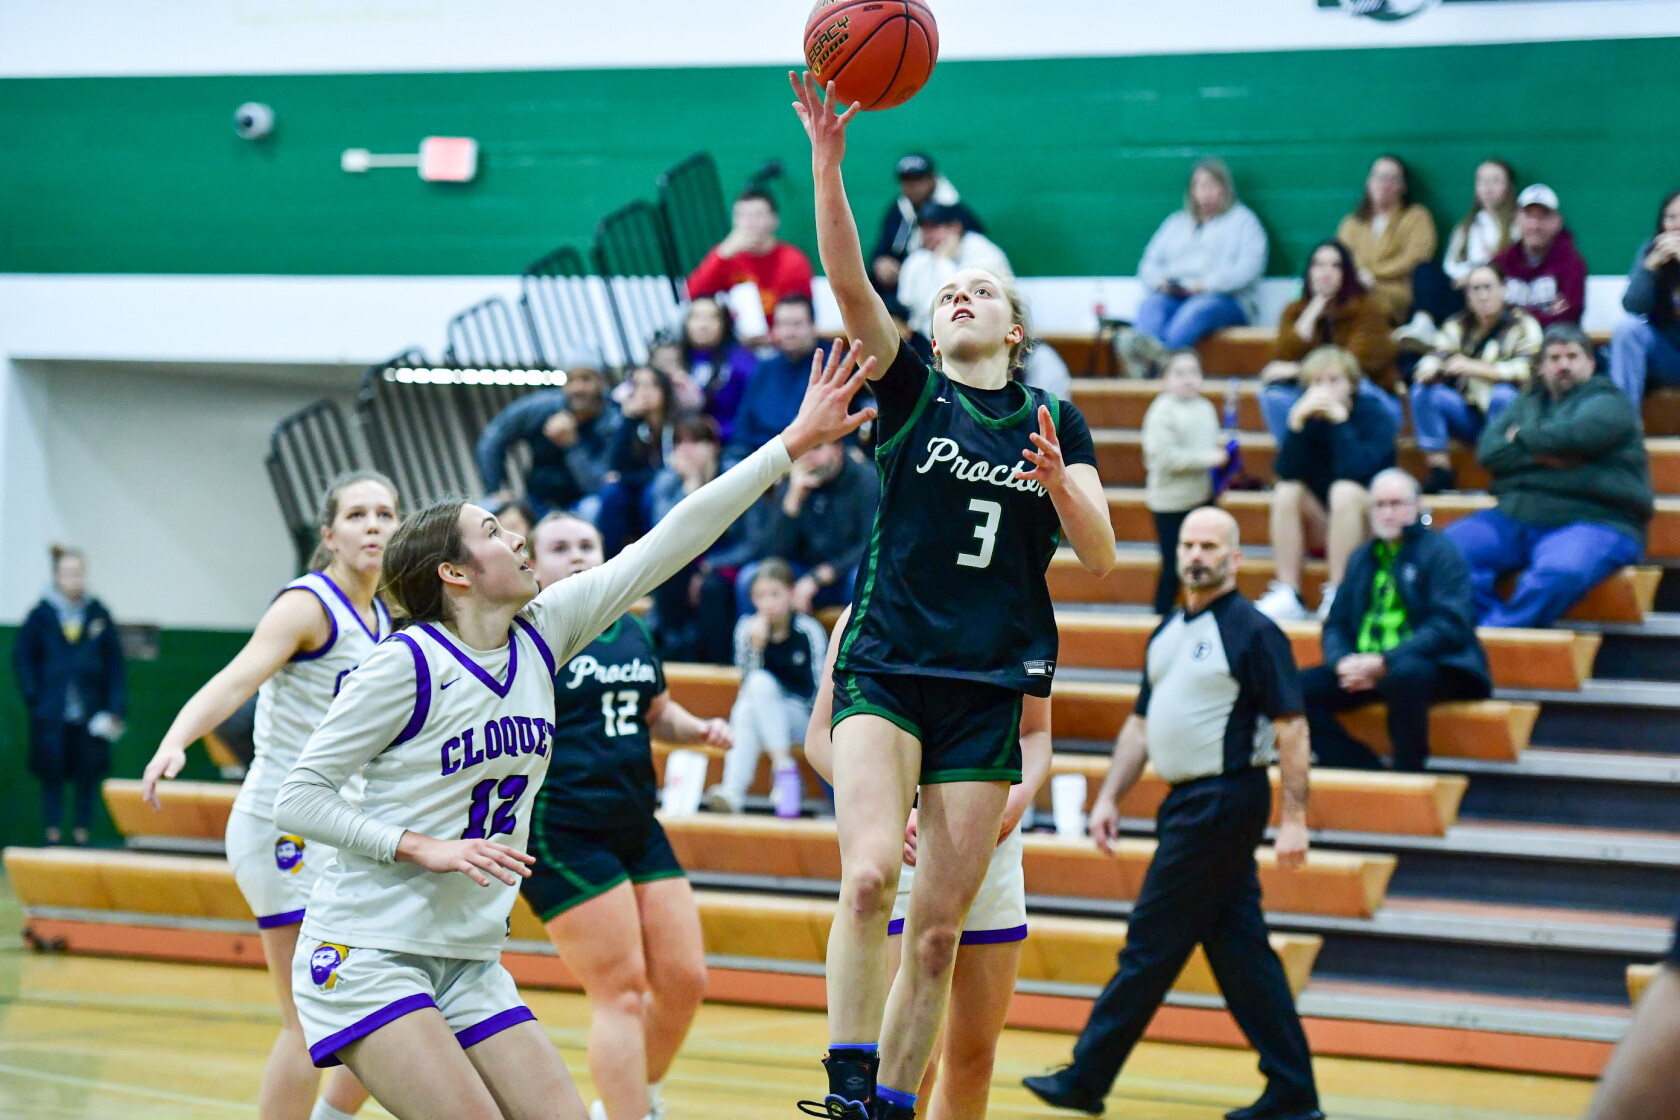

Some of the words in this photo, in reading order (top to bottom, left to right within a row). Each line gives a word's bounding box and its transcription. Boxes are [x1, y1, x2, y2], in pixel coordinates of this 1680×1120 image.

[956, 498, 1002, 569] 3
[601, 689, 641, 737] 12
[460, 774, 529, 840] 12
